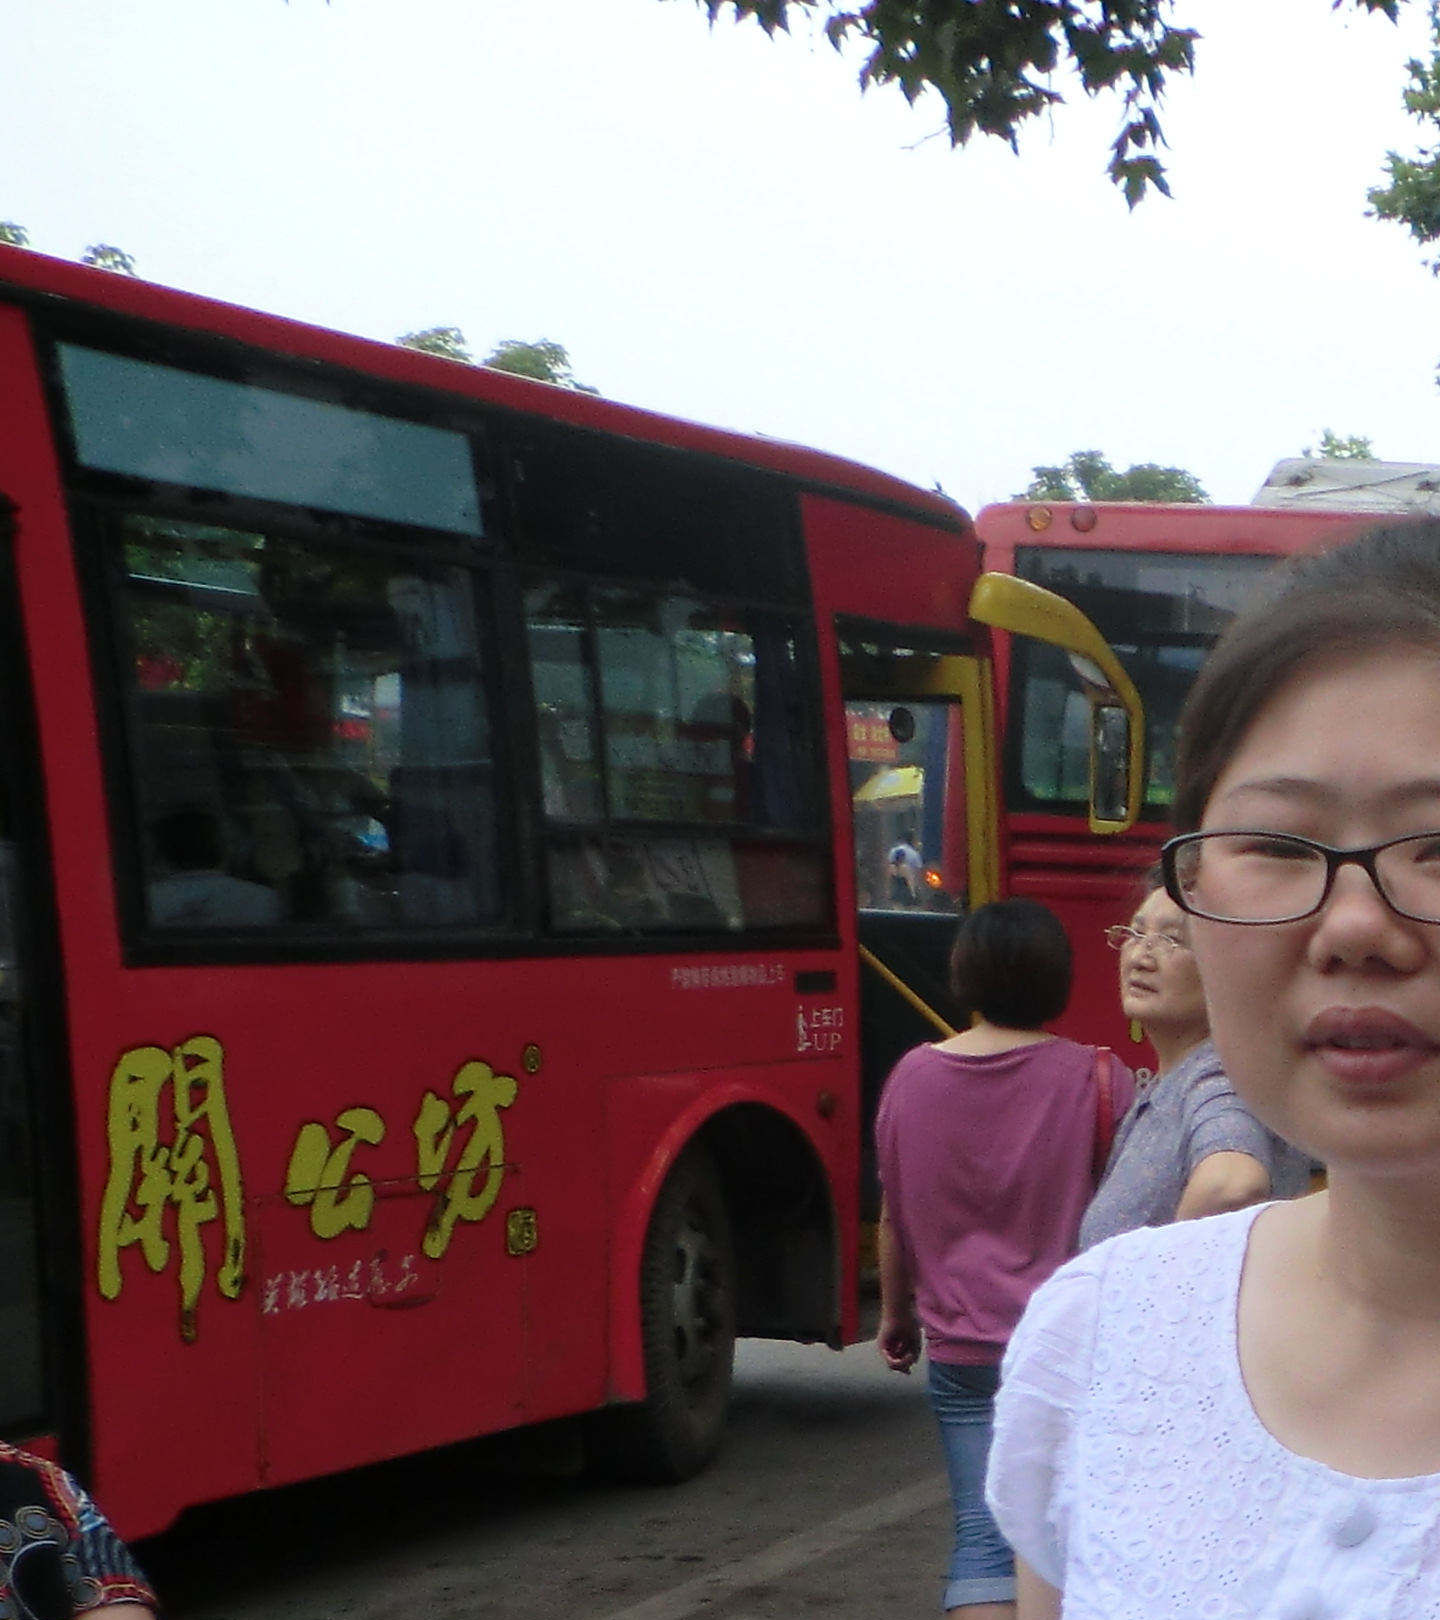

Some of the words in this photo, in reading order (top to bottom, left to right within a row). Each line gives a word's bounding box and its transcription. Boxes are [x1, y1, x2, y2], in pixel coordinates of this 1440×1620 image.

[810, 1007, 844, 1028] 上车门
[813, 1033, 842, 1051] UP
